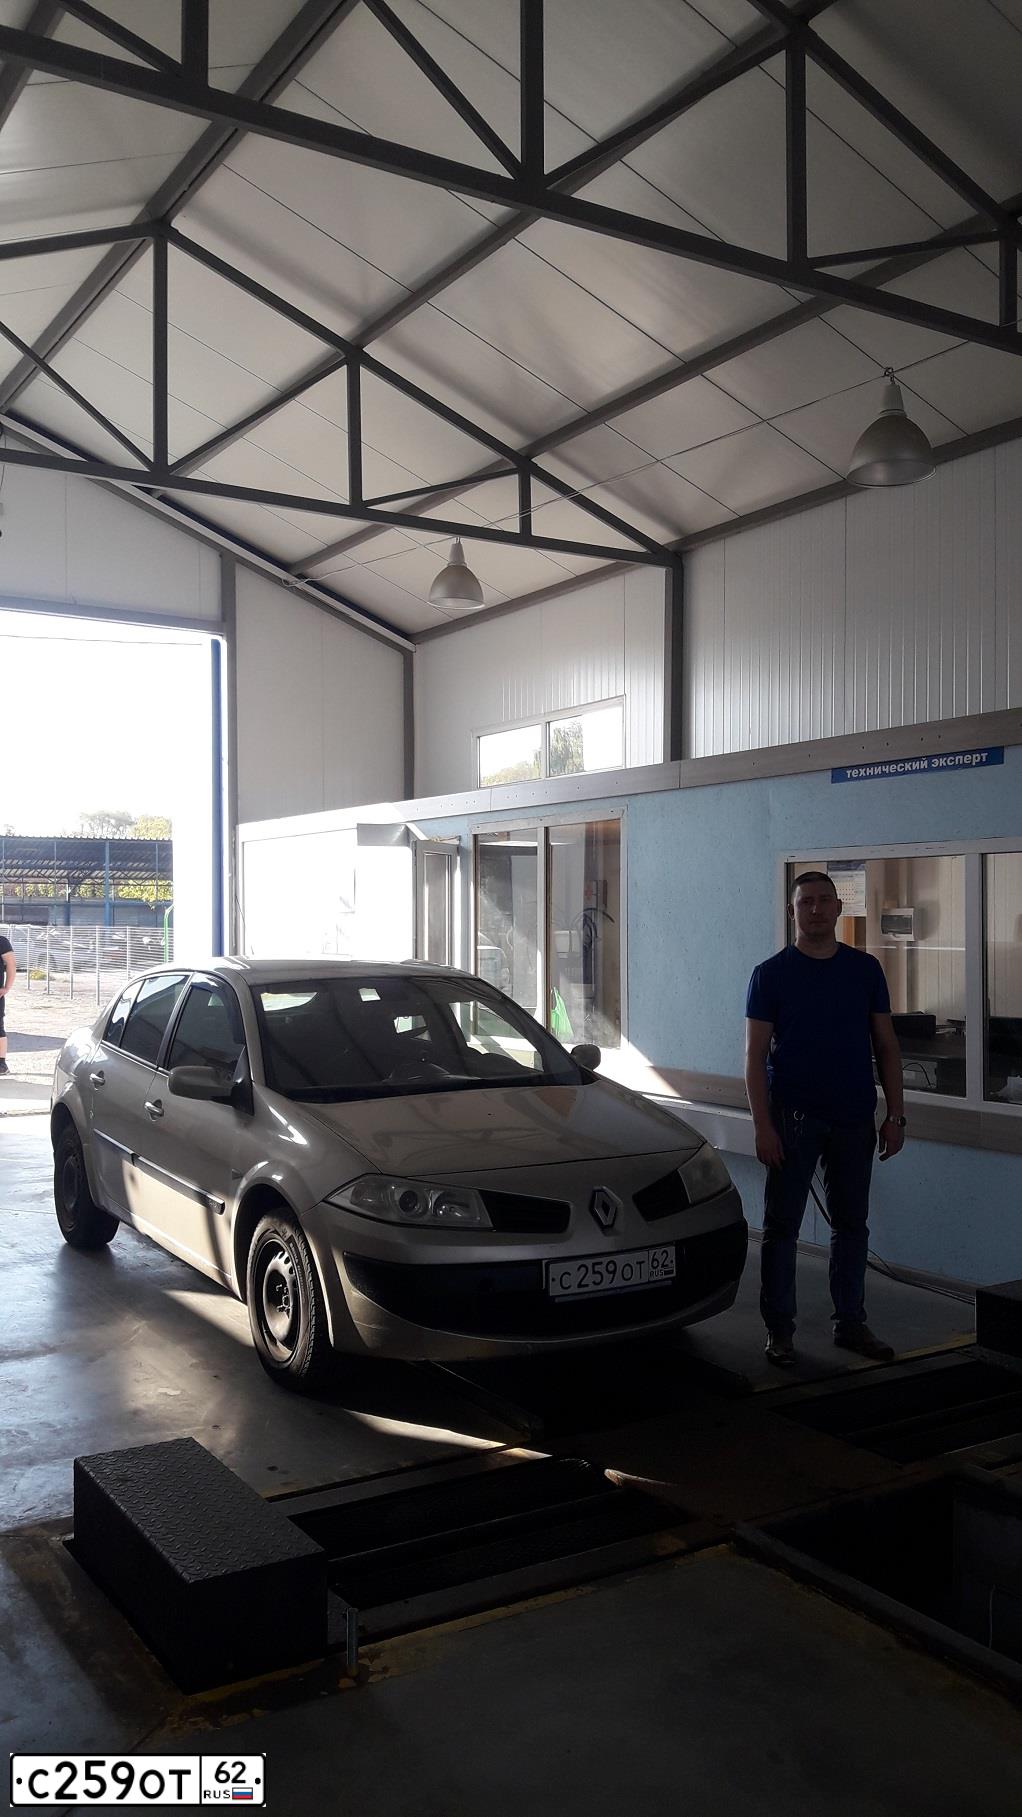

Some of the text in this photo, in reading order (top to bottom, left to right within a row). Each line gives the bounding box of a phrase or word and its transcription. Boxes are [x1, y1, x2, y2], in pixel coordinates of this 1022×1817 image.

[846, 752, 988, 778] технический эксперт
[650, 1249, 669, 1269] 62
